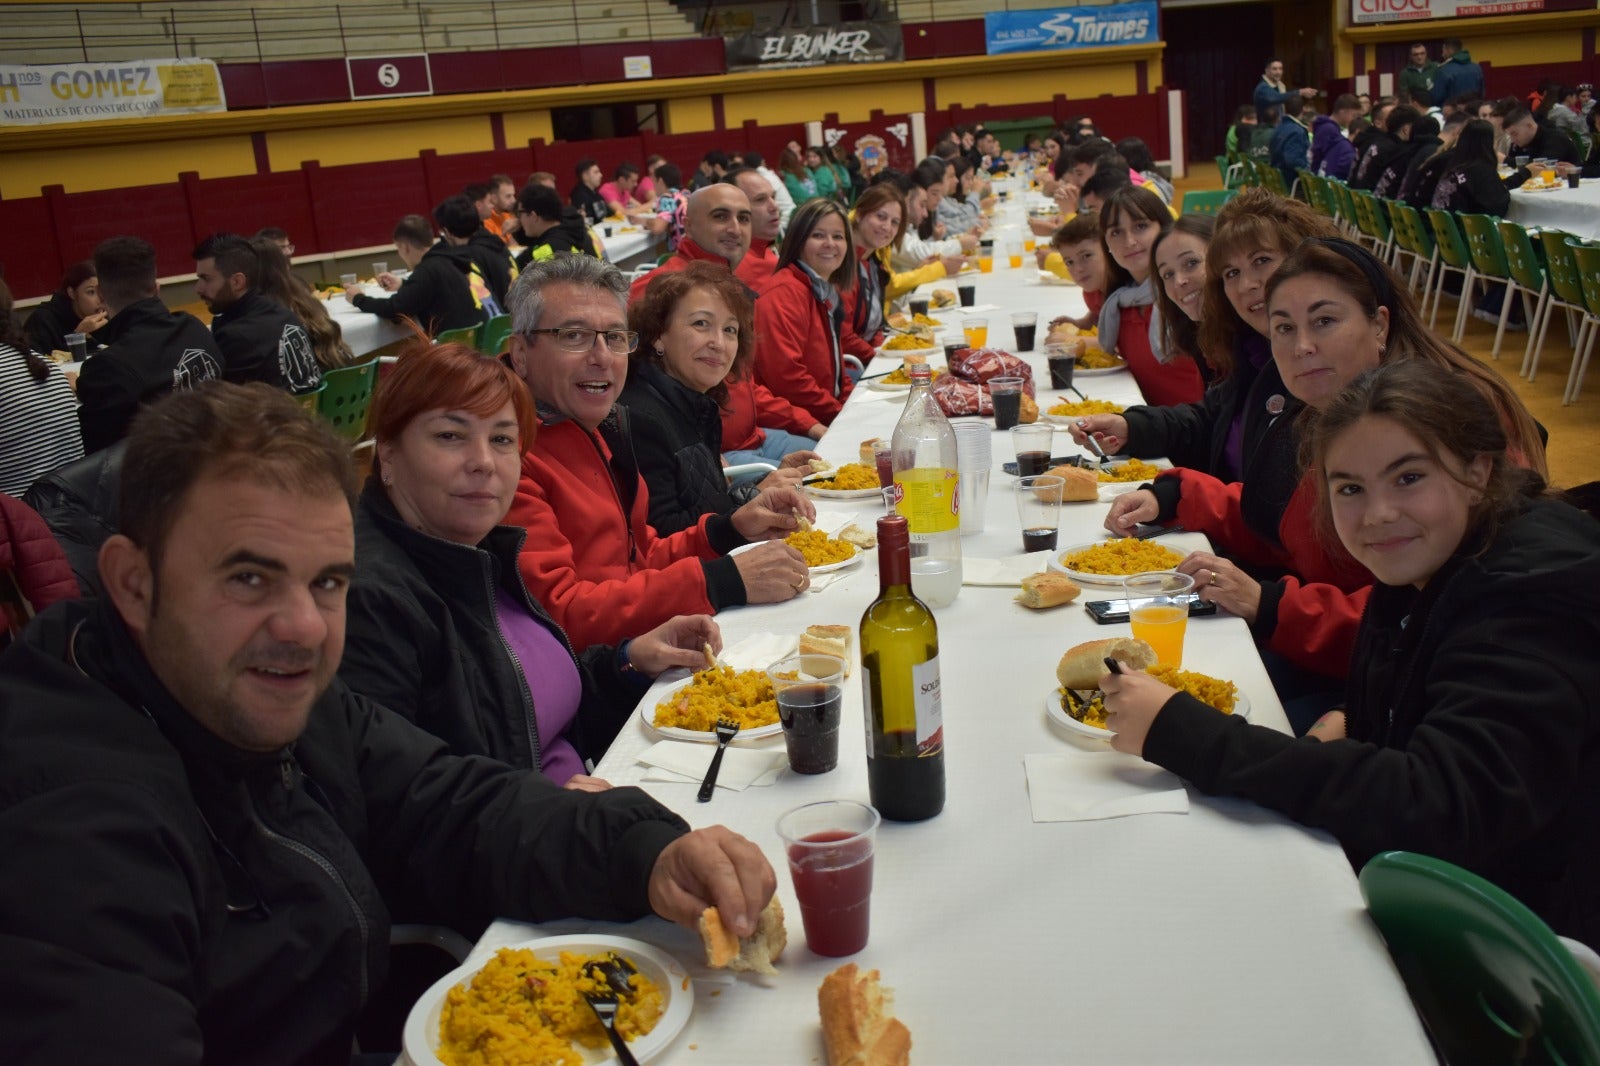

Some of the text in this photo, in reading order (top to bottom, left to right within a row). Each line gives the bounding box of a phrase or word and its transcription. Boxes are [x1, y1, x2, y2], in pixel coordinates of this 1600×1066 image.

[1072, 17, 1150, 43] Tormes
[760, 29, 870, 60] EL BUNKER
[51, 67, 156, 100] GOMEZ
[384, 66, 395, 86] 5
[4, 106, 68, 120] MATERIALES
[69, 105, 82, 116] DE
